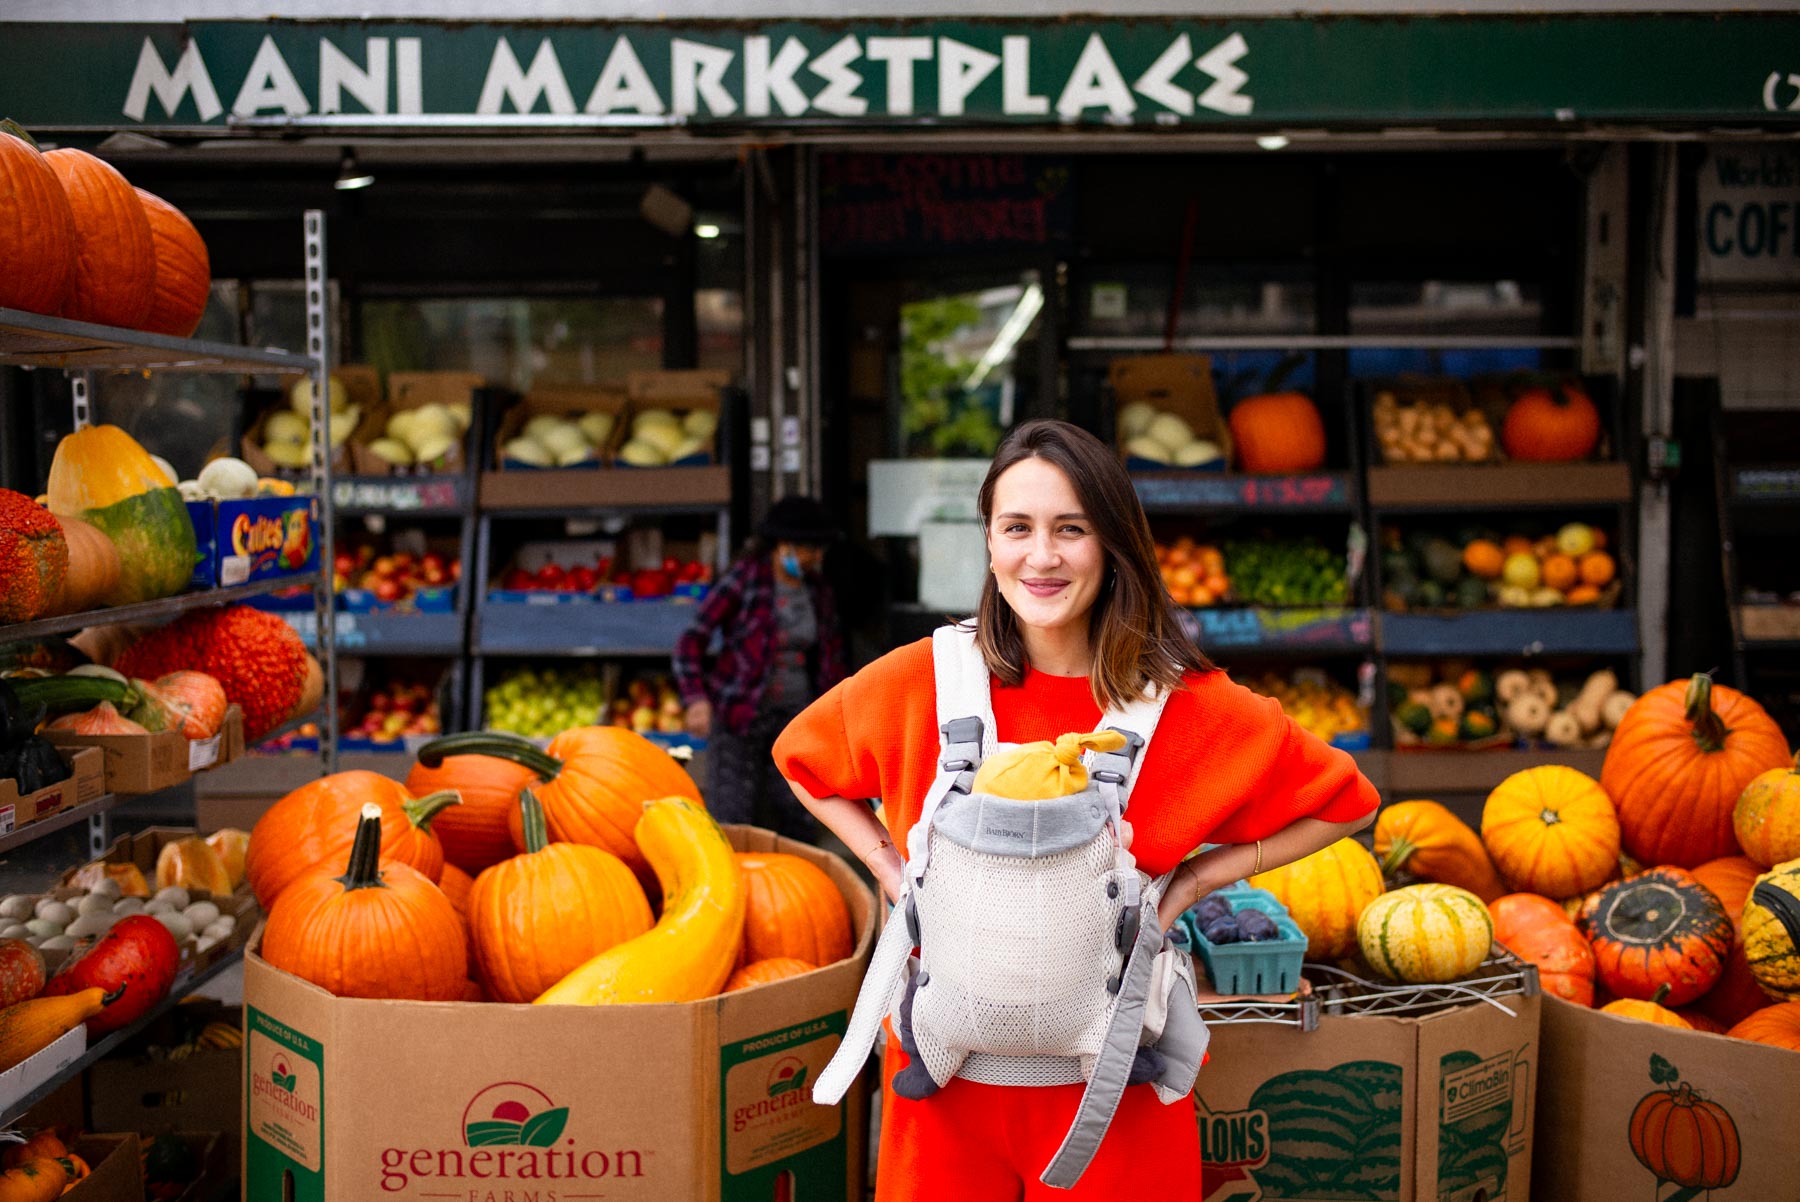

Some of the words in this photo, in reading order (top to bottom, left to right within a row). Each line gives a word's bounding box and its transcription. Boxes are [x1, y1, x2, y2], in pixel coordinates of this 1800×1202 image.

[123, 36, 422, 122] MANI
[475, 33, 1253, 118] MARKETPLACE
[1706, 202, 1800, 258] COF
[742, 1033, 789, 1053] PRODUCE
[790, 1028, 803, 1040] OF
[253, 1072, 316, 1122] generation
[734, 1080, 813, 1132] generati
[1459, 1069, 1510, 1099] ClimaBin
[1198, 1114, 1265, 1163] LONS
[380, 1138, 645, 1192] generation
